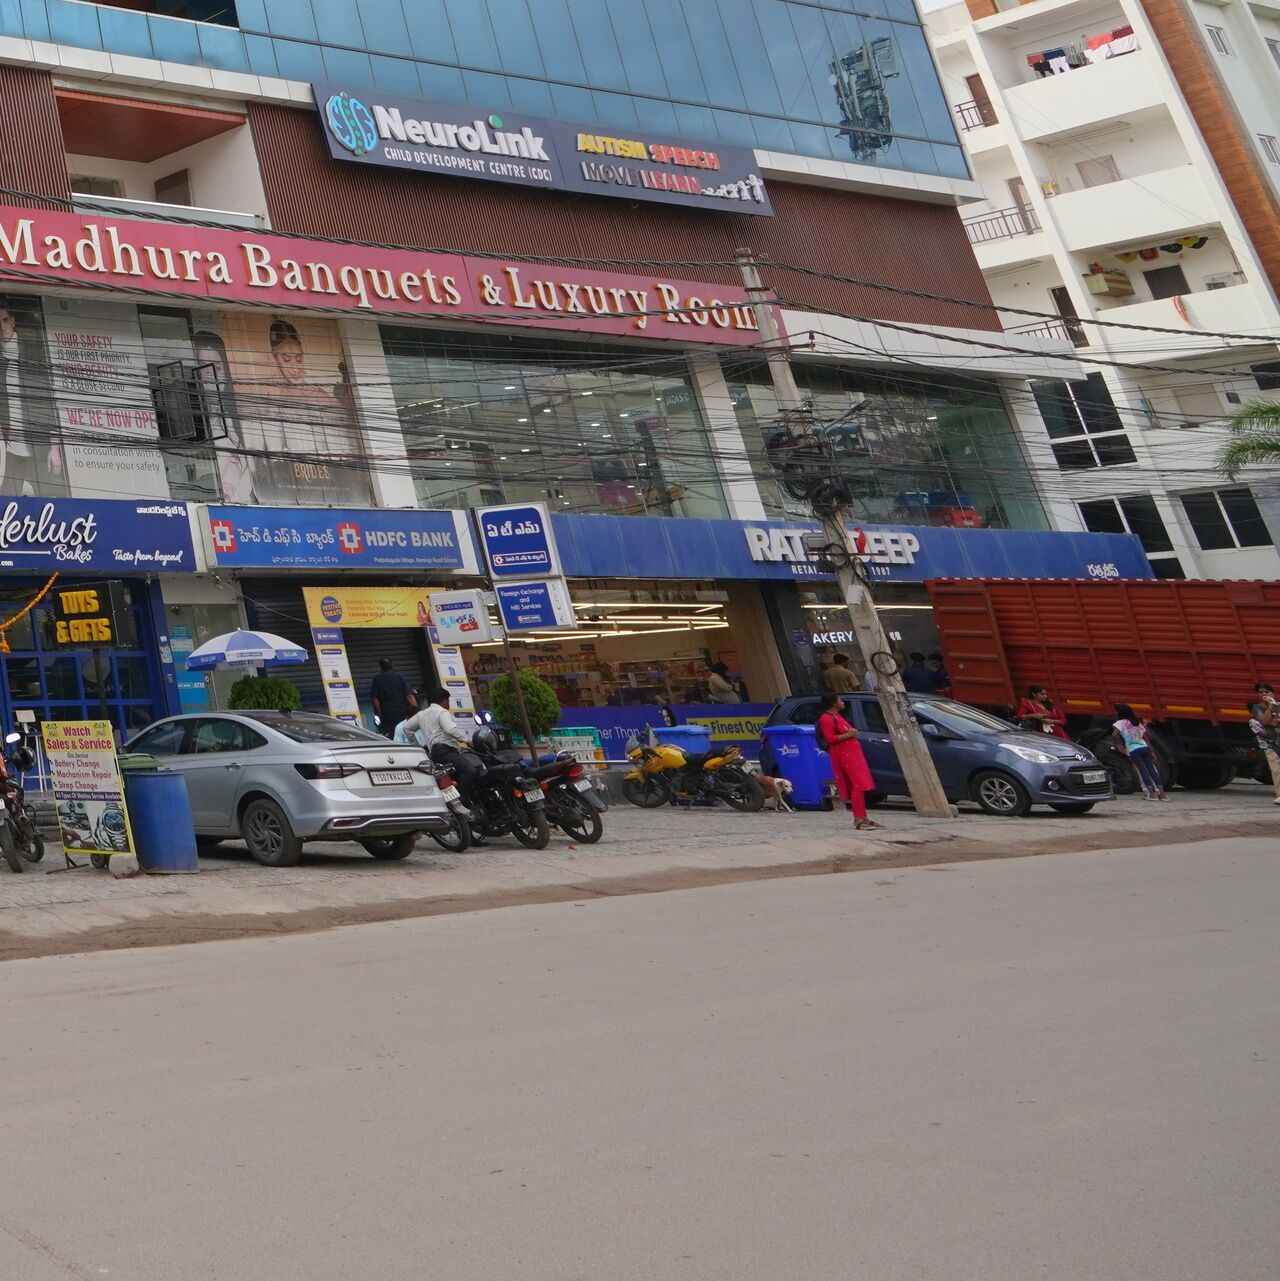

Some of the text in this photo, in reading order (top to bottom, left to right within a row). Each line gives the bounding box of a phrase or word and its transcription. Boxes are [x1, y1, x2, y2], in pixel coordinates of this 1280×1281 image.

[372, 105, 550, 161] NeuroLink
[576, 133, 721, 170] AUTISM SPEECH
[384, 147, 552, 182] CHILD DEVELOPMENT CENTRE (CDC)
[581, 162, 702, 195] MOVE LEARN
[241, 243, 462, 308] Banquets
[481, 274, 506, 306] &
[505, 267, 648, 329] Luxury
[656, 283, 778, 331] Room
[55, 332, 113, 350] YOUR SAFETY
[66, 408, 132, 428] WE'RE NOW
[83, 446, 134, 456] consultation
[75, 460, 160, 474] to ensure your safety
[365, 531, 454, 548] HDFC BANK
[53, 545, 92, 563] Bakes
[112, 549, 183, 566] Taste from beyond
[872, 567, 890, 576] 1987
[521, 588, 545, 596] Exchange
[59, 590, 100, 614] TOYS
[56, 618, 112, 643] & GIFTS
[63, 726, 91, 736] Watch
[712, 722, 743, 735] Finest
[46, 739, 112, 749] Sales & Service
[55, 760, 100, 769] Battery Change
[92, 771, 112, 779] Repair
[58, 782, 98, 791] Strap Change
